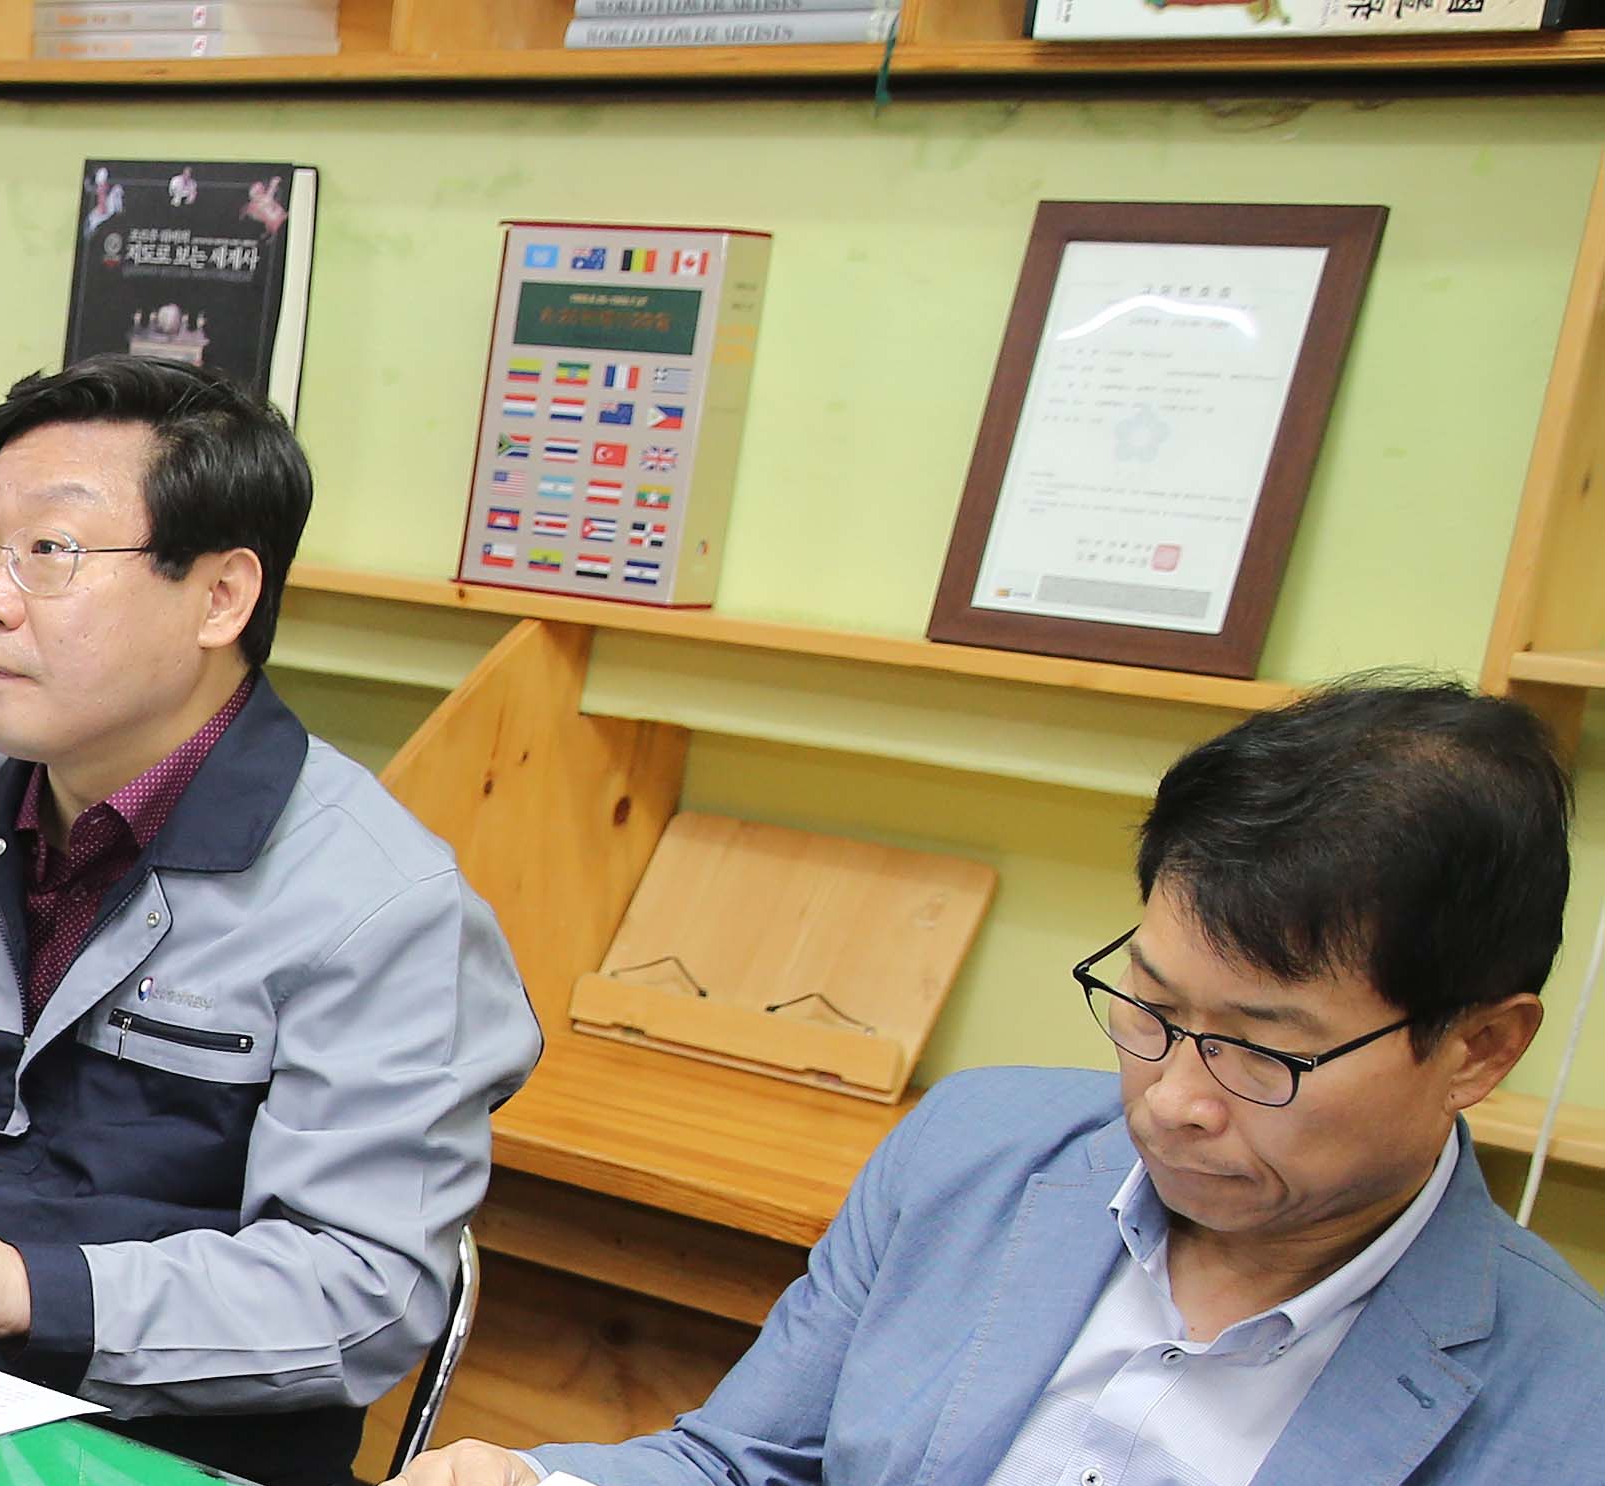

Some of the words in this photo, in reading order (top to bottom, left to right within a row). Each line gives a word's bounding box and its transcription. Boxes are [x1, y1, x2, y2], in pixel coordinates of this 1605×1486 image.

[126, 243, 171, 265] 지도로
[173, 246, 207, 269] 보는
[210, 246, 260, 271] 세계사
